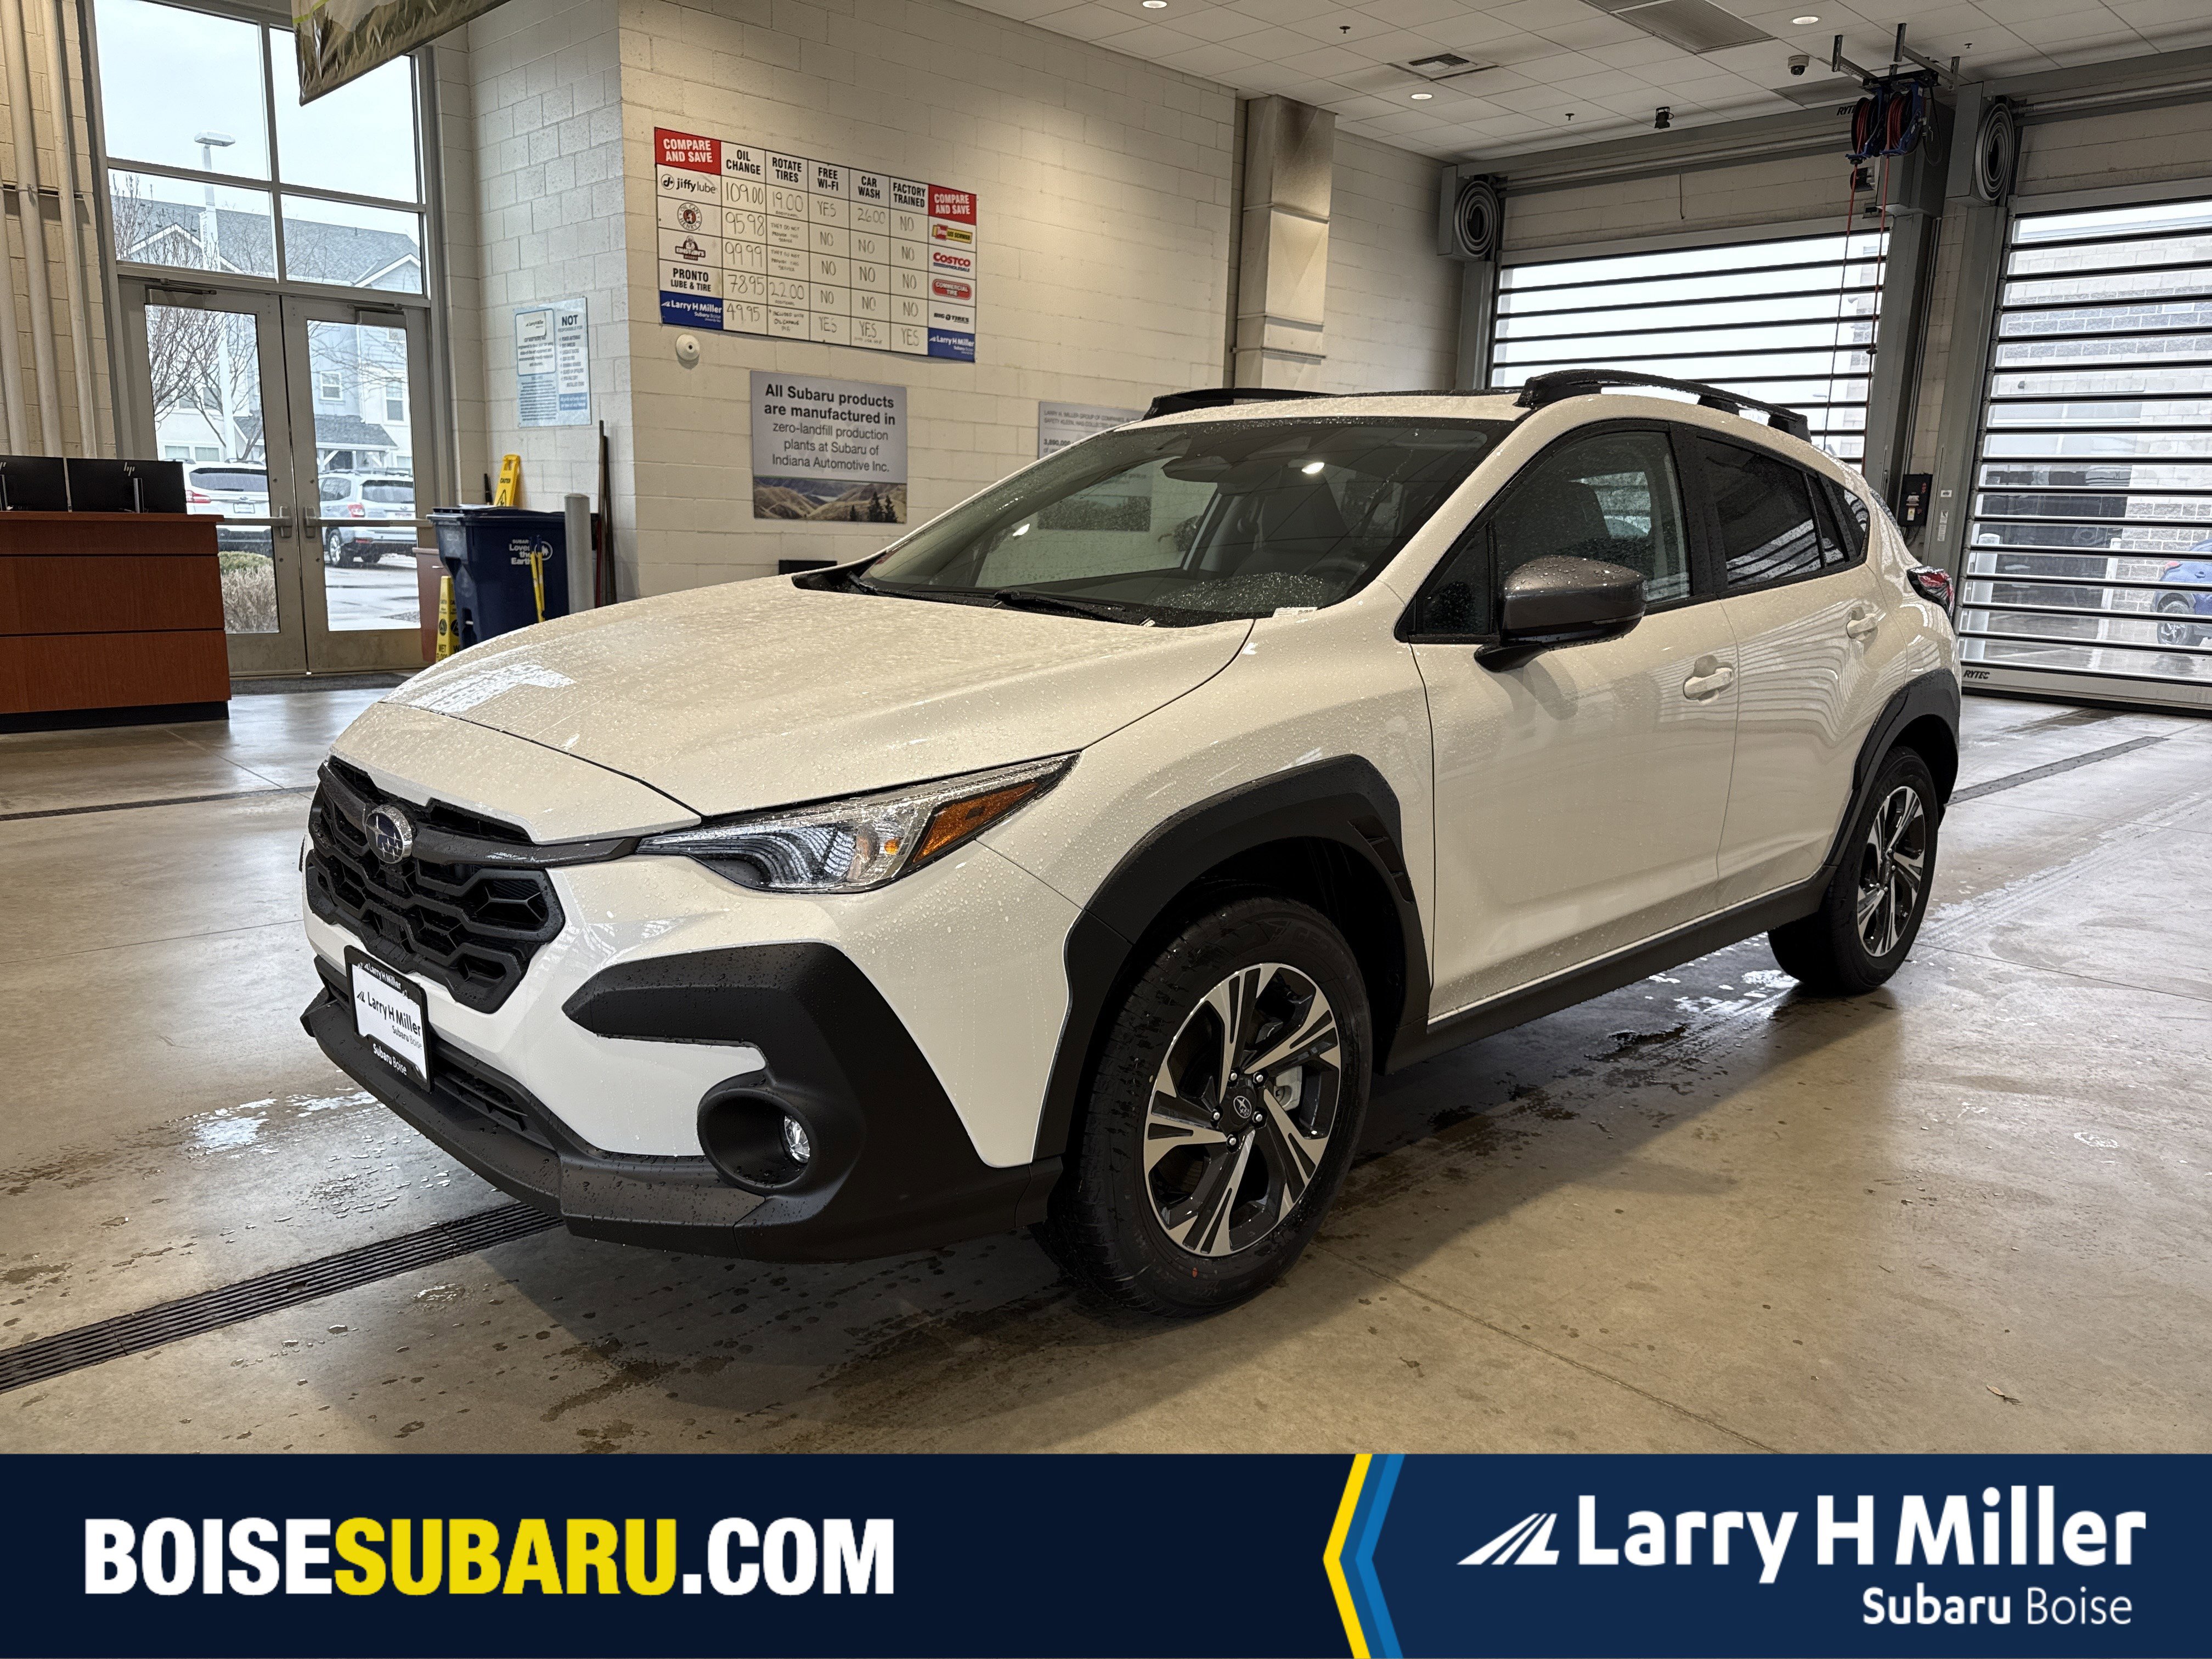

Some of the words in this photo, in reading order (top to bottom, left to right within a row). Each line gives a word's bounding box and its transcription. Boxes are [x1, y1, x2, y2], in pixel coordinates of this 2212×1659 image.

[1837, 105, 1855, 116] RYT
[663, 138, 712, 151] COMPARE
[665, 150, 686, 162] AND
[687, 151, 713, 163] SAVE
[737, 149, 751, 162] OIL
[726, 159, 761, 175] CHANGE
[772, 157, 802, 172] ROTATE
[775, 169, 799, 183] TIRES
[818, 167, 838, 180] FREE
[817, 178, 839, 191] WI-FI
[861, 176, 877, 188] CAR
[857, 186, 881, 199] WASH
[893, 182, 926, 198] FACTORY
[893, 193, 925, 208] TRAINED
[934, 194, 970, 204] COMPARE
[816, 200, 837, 217] YES
[935, 205, 951, 215] AND
[952, 205, 971, 215] SAVE
[900, 216, 915, 232] NO
[820, 231, 834, 246] NO
[858, 239, 875, 254] NO
[901, 245, 915, 261] NO
[933, 252, 970, 267] COSTCO
[673, 268, 709, 282] PRONTO
[821, 261, 837, 276] NO
[859, 266, 876, 283] NO
[671, 279, 687, 289] LUBE
[697, 283, 712, 292] TIRE
[902, 273, 917, 290] NO
[820, 290, 834, 304] NO
[861, 296, 876, 311] NO
[671, 300, 691, 312] Larry
[692, 302, 698, 311] H
[699, 303, 722, 313] Miller
[902, 301, 919, 318] NO
[562, 314, 578, 326] NOT
[819, 316, 838, 333] YES
[859, 320, 877, 338] YES
[901, 328, 920, 347] YES
[765, 384, 783, 397] All
[787, 386, 835, 402] Subaru
[839, 393, 894, 408] products
[764, 404, 786, 416] are
[791, 407, 881, 424] manufactured
[884, 413, 896, 425] in
[772, 422, 833, 436] zero-landfill
[835, 428, 889, 441] production
[784, 439, 816, 452] plants
[819, 442, 828, 452] at
[831, 442, 867, 455] Subaru
[869, 445, 879, 456] of
[772, 454, 810, 467] Indiana
[812, 456, 870, 471] Automotive
[872, 461, 890, 472] Inc.
[1963, 669, 1990, 679] RYTEC
[369, 963, 381, 980] Larry
[382, 970, 386, 981] H
[386, 974, 402, 990] Miller
[367, 991, 387, 1020] Larry
[387, 1004, 395, 1022] H
[396, 1009, 421, 1037] Miller
[392, 1025, 409, 1042] Subaru
[410, 1035, 422, 1049] Boise
[373, 1043, 392, 1065] Subaru
[392, 1056, 407, 1076] Boise
